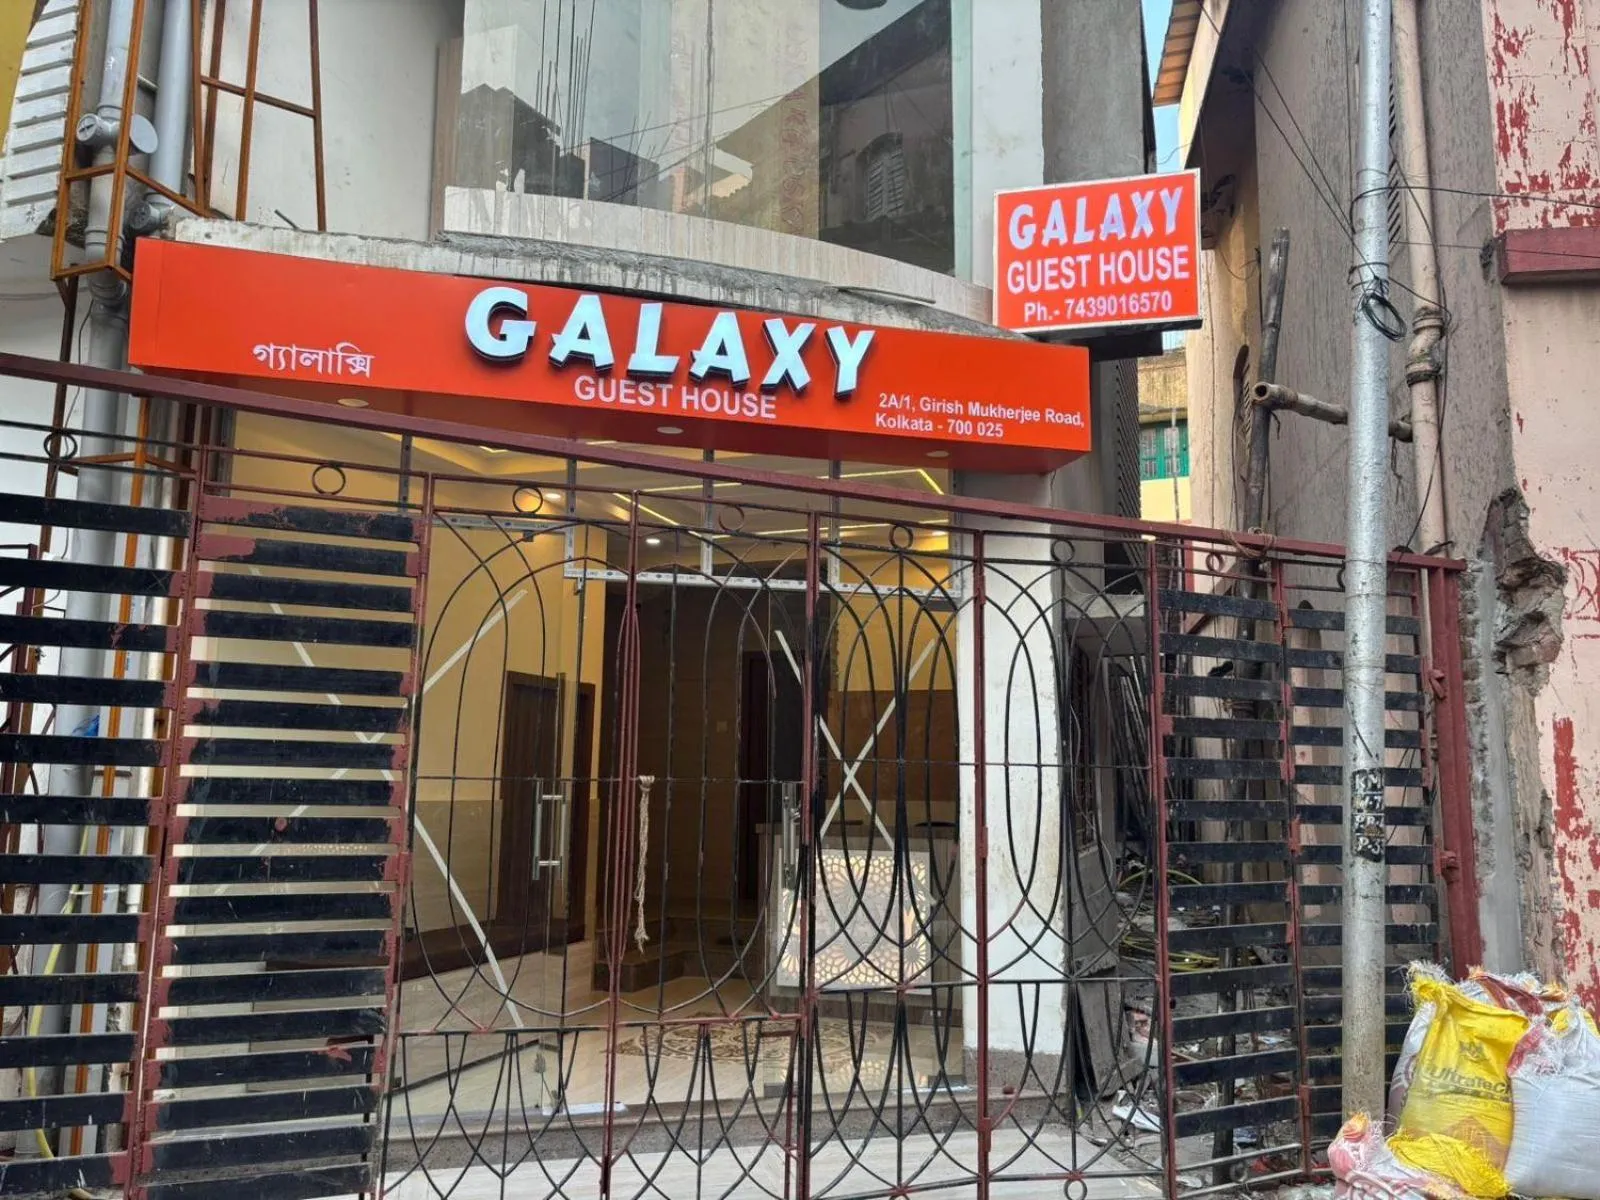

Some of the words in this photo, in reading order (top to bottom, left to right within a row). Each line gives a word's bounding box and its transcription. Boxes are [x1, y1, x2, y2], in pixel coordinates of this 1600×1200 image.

[1008, 186, 1184, 250] GALAXY
[1006, 254, 1092, 295] GUEST
[1099, 245, 1190, 286] HOUSE
[1064, 290, 1173, 319] 7439016570
[252, 341, 375, 379] গ্যালাক্সি
[464, 286, 876, 396] GALAXY
[574, 375, 674, 410] GUEST
[680, 388, 777, 419] HOUSE
[879, 392, 916, 412] 2A/1,
[919, 396, 964, 415] Girish
[968, 401, 1041, 424] Mukherjee
[1045, 408, 1085, 427] Road,
[875, 413, 933, 432] Kolkata
[947, 418, 973, 436] 700
[977, 420, 1004, 438] 025
